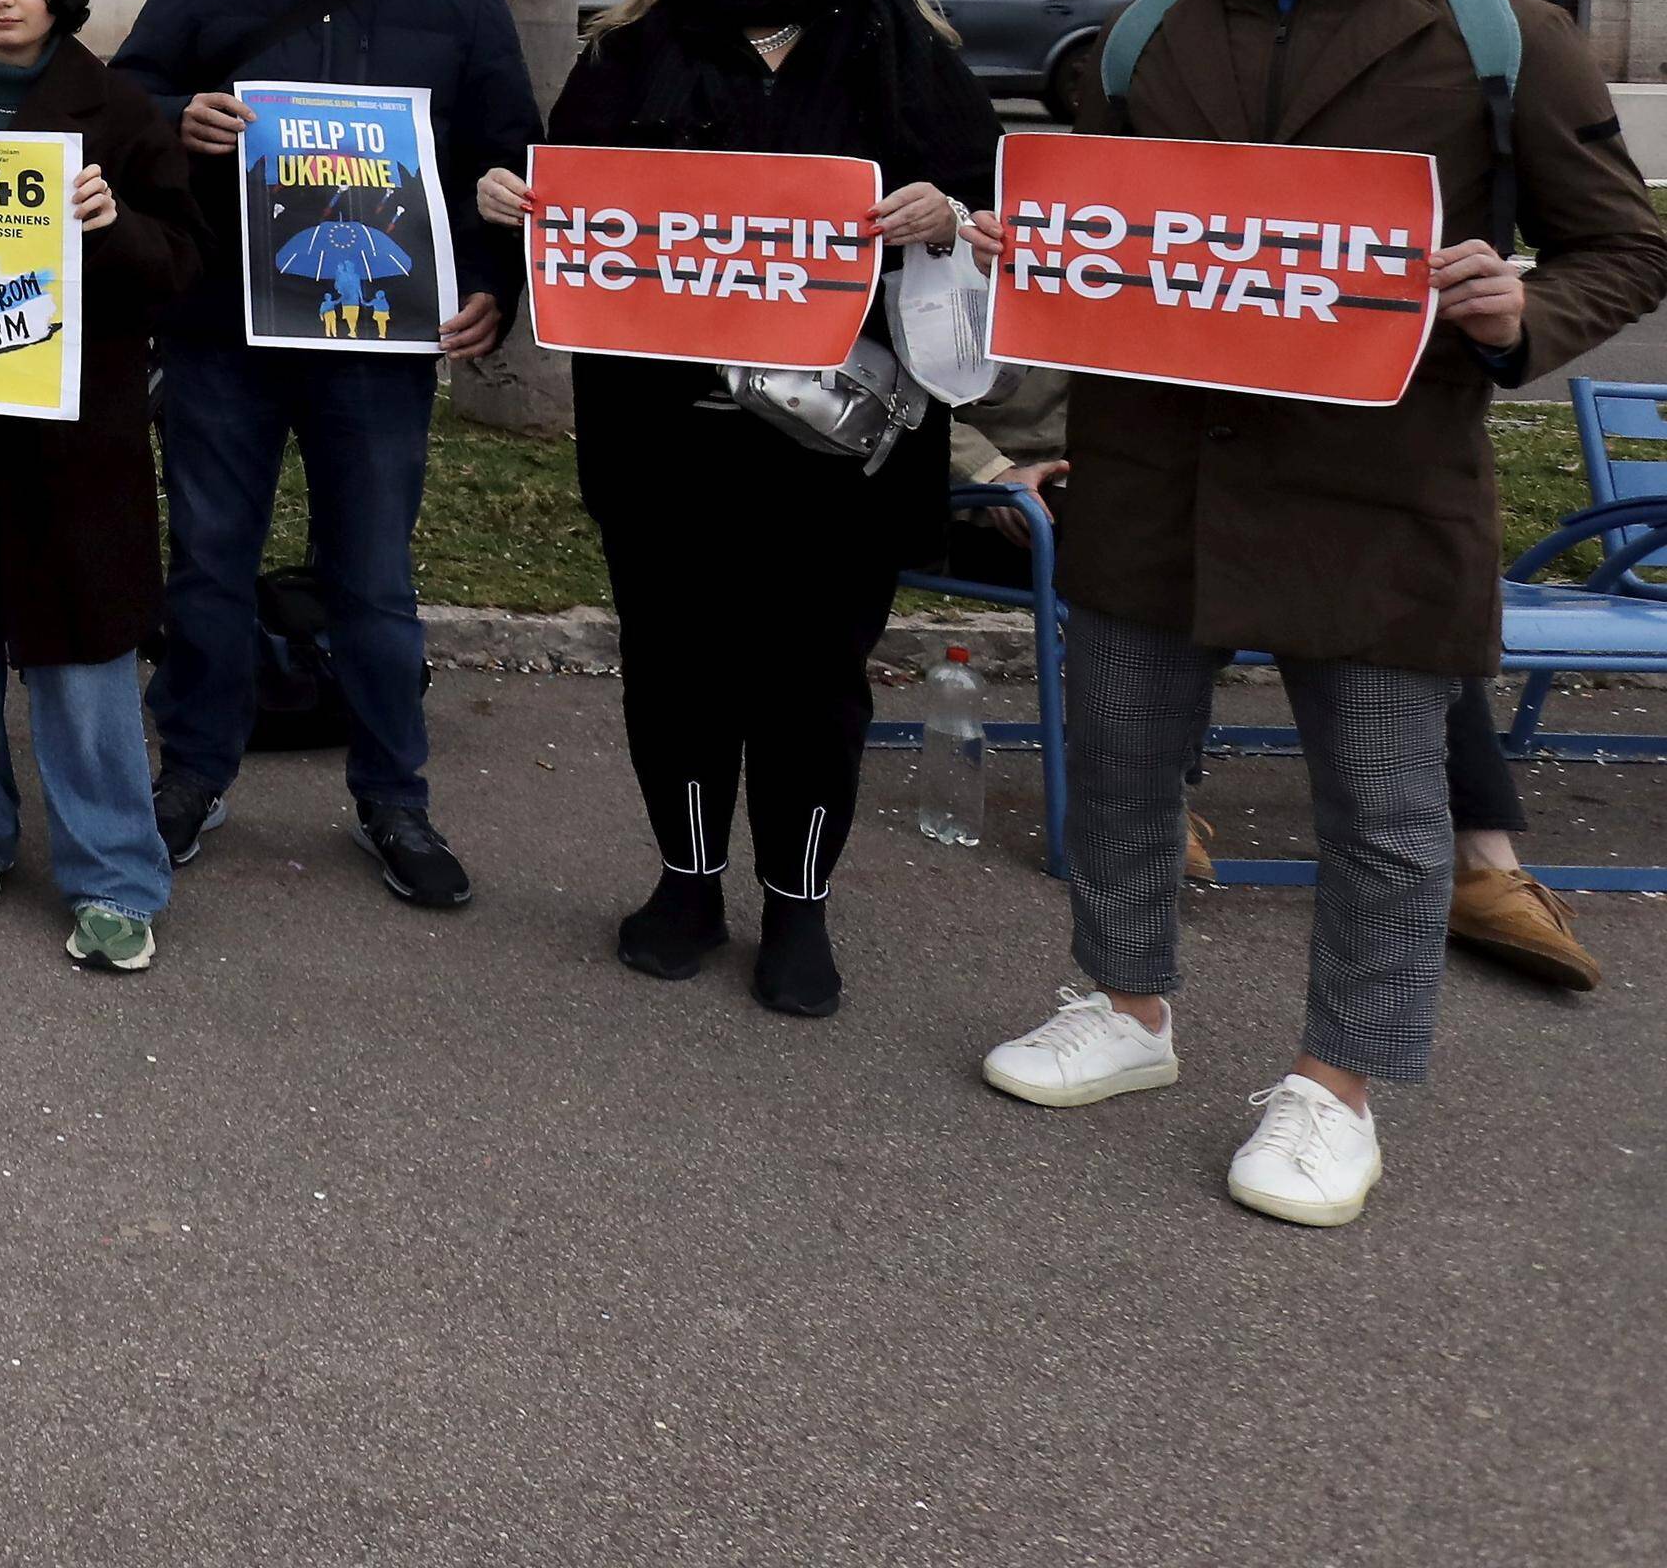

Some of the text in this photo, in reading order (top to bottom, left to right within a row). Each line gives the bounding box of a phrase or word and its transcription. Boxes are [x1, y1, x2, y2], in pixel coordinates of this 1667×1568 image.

[279, 118, 385, 154] HELP TO
[278, 154, 396, 188] UKRAINE
[545, 205, 860, 262] NO PUTIN
[1017, 199, 1410, 277] NO PUTIN
[543, 247, 810, 305] NO WAR
[1013, 248, 1340, 323] NO WAR
